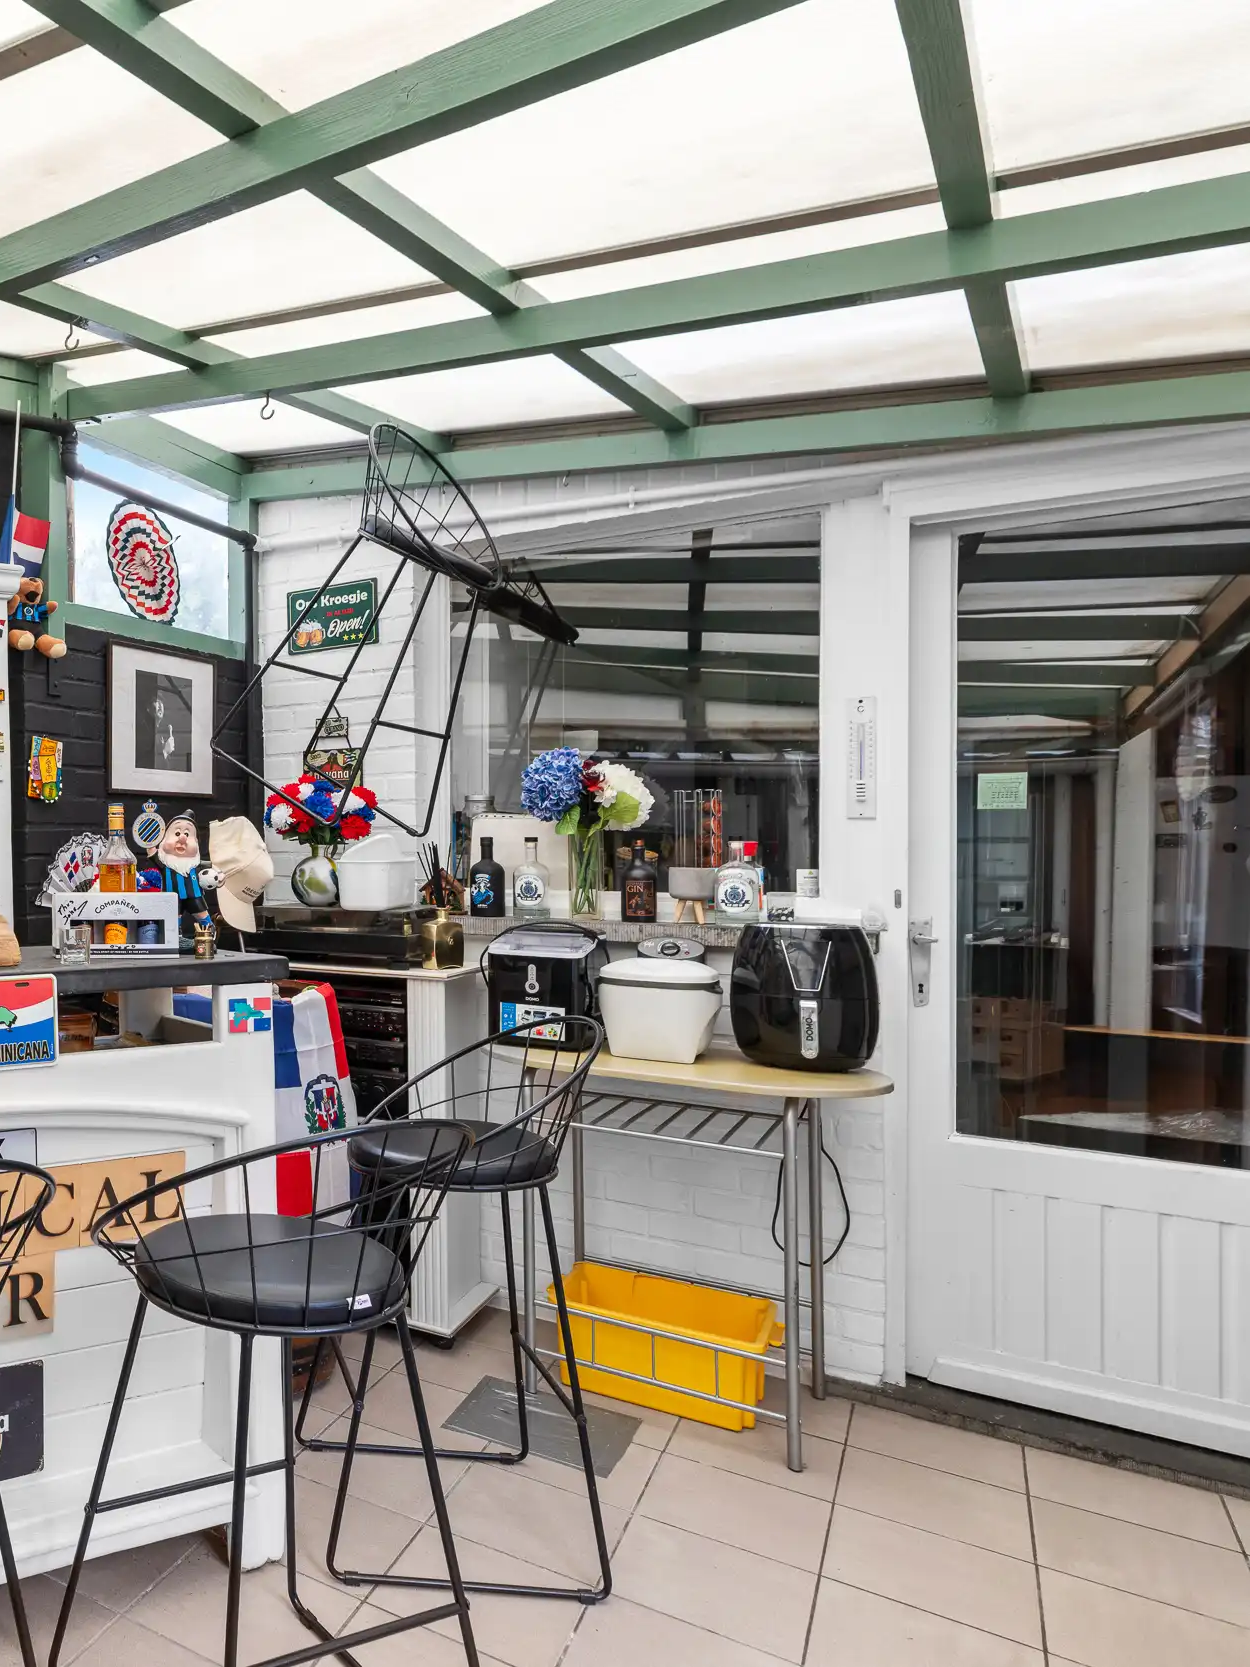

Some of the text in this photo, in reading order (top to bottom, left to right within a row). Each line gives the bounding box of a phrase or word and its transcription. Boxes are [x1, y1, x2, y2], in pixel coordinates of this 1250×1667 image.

[321, 590, 368, 607] Kroegje
[627, 885, 644, 893] GIN
[94, 898, 140, 915] COMPAÑERO
[805, 1017, 813, 1041] DOMO
